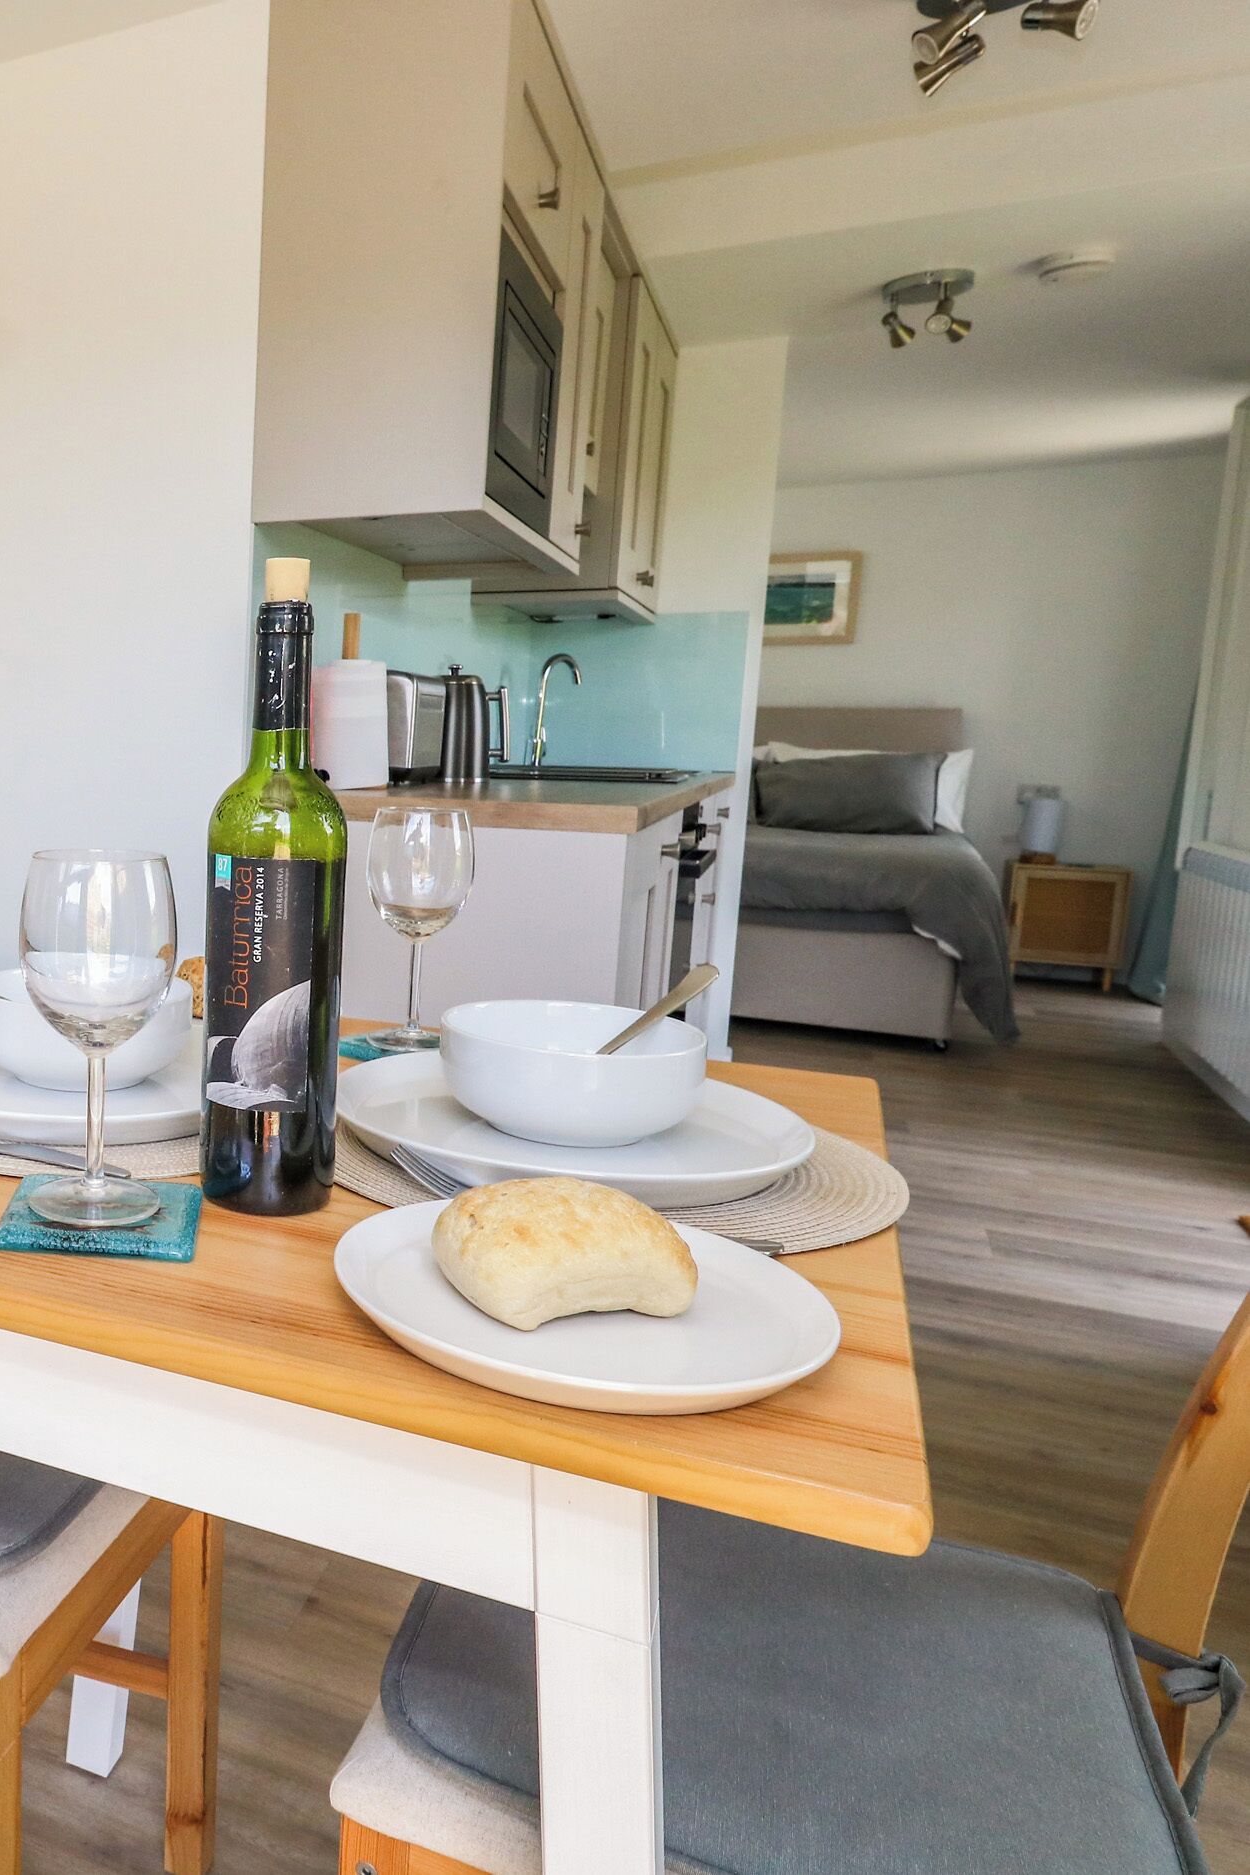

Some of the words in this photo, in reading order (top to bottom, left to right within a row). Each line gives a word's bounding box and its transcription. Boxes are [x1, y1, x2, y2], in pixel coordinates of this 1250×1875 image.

[218, 858, 228, 872] 87
[256, 866, 265, 890] 2014
[275, 867, 285, 920] TARRAGONA
[254, 892, 264, 934] RESERVA
[224, 866, 253, 1009] Baturrica
[253, 935, 263, 963] GRAN
